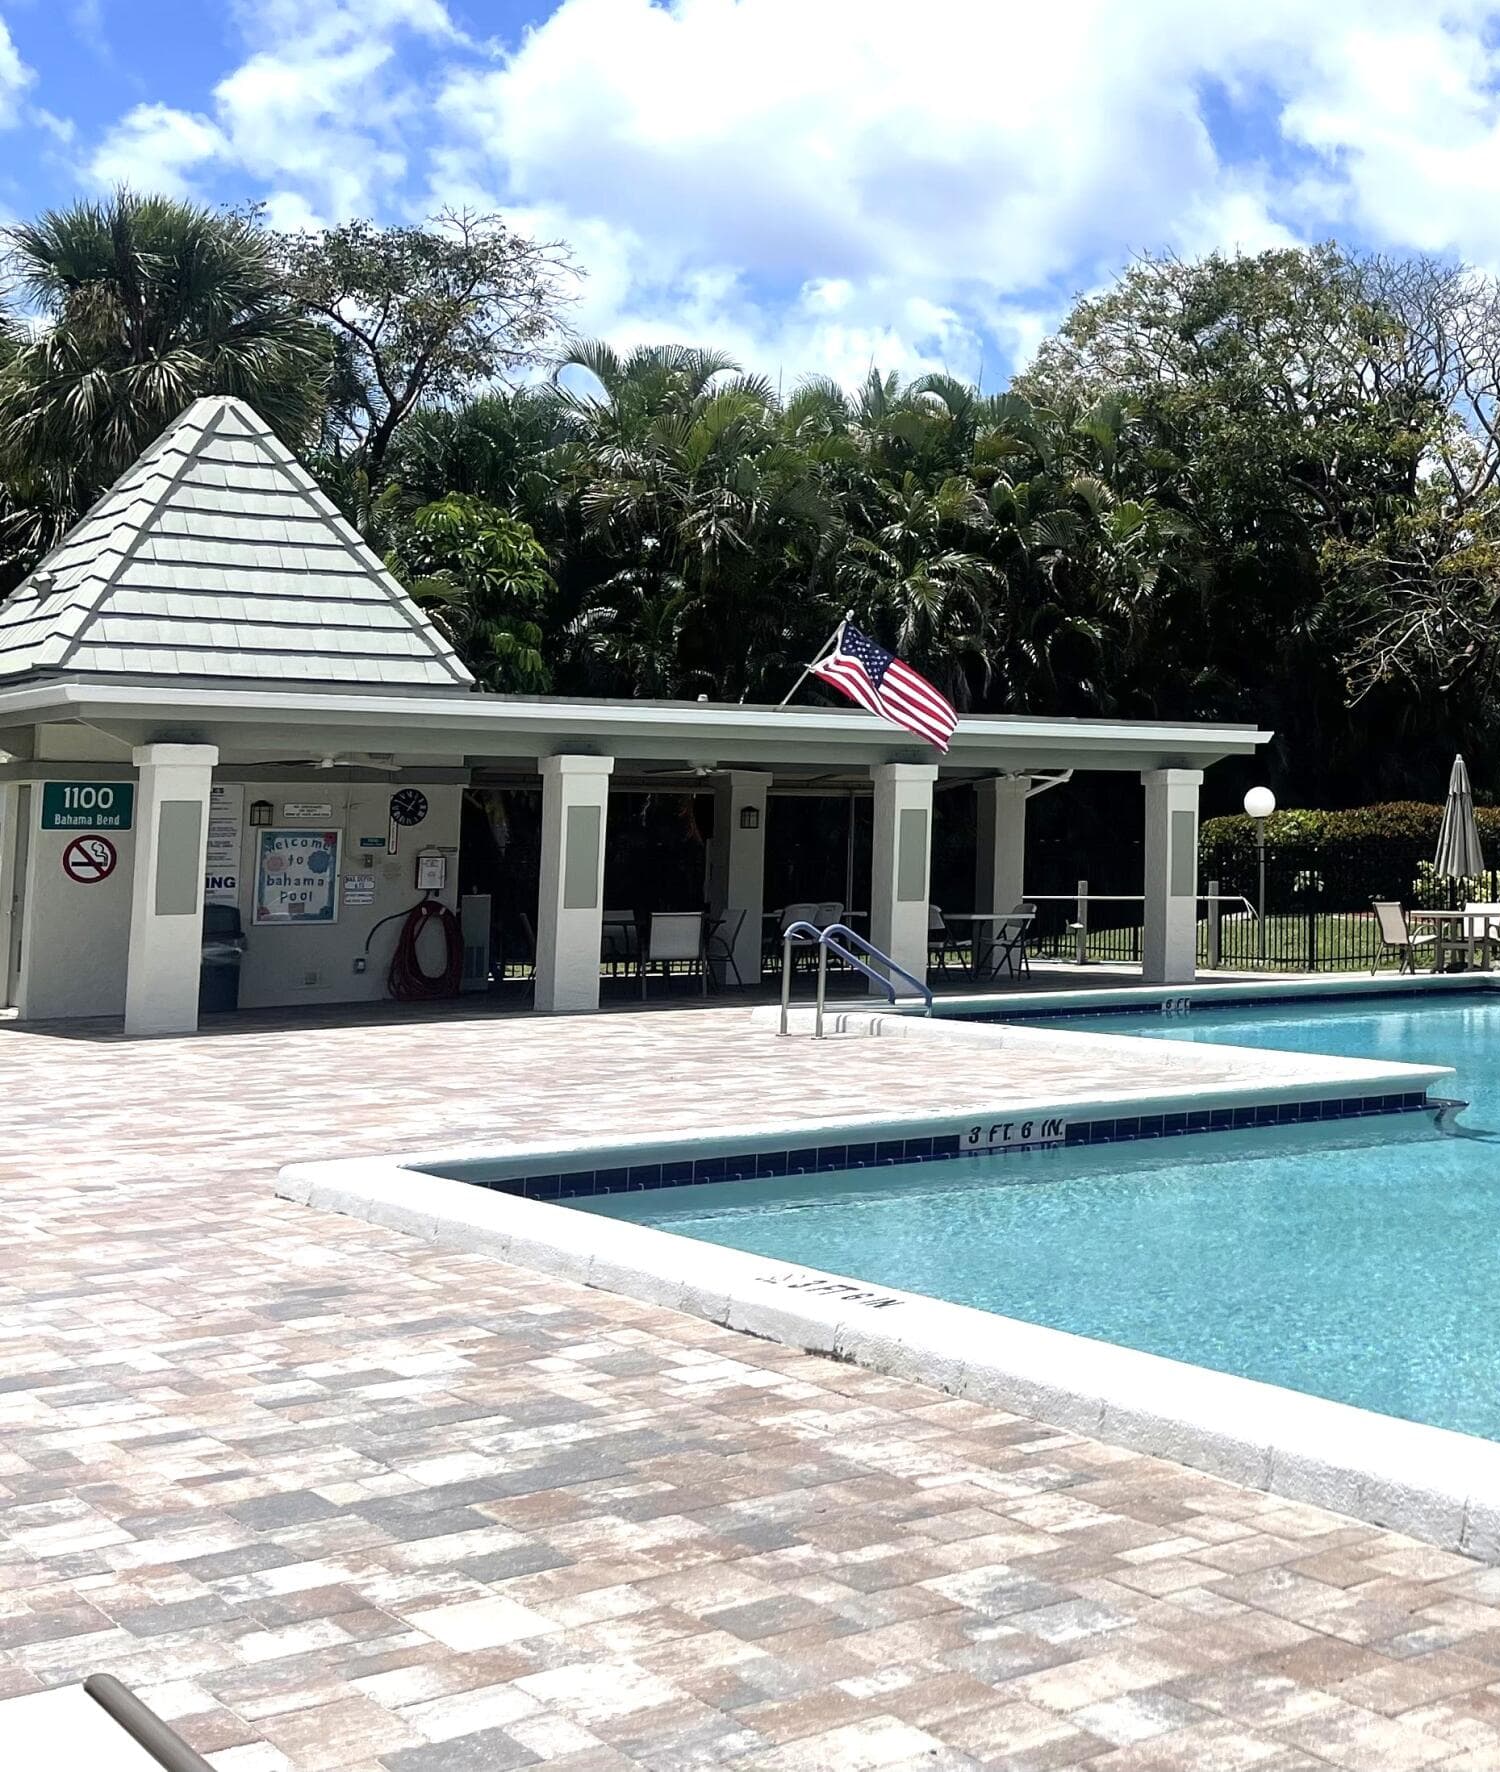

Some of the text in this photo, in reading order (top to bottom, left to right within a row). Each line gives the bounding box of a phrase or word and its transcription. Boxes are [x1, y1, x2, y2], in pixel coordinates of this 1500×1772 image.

[64, 787, 114, 809] 1100
[54, 813, 120, 825] Bahama Bend
[288, 854, 304, 866] to
[266, 871, 325, 887] bahama
[968, 1126, 982, 1144] 3
[1021, 1121, 1034, 1139] 6
